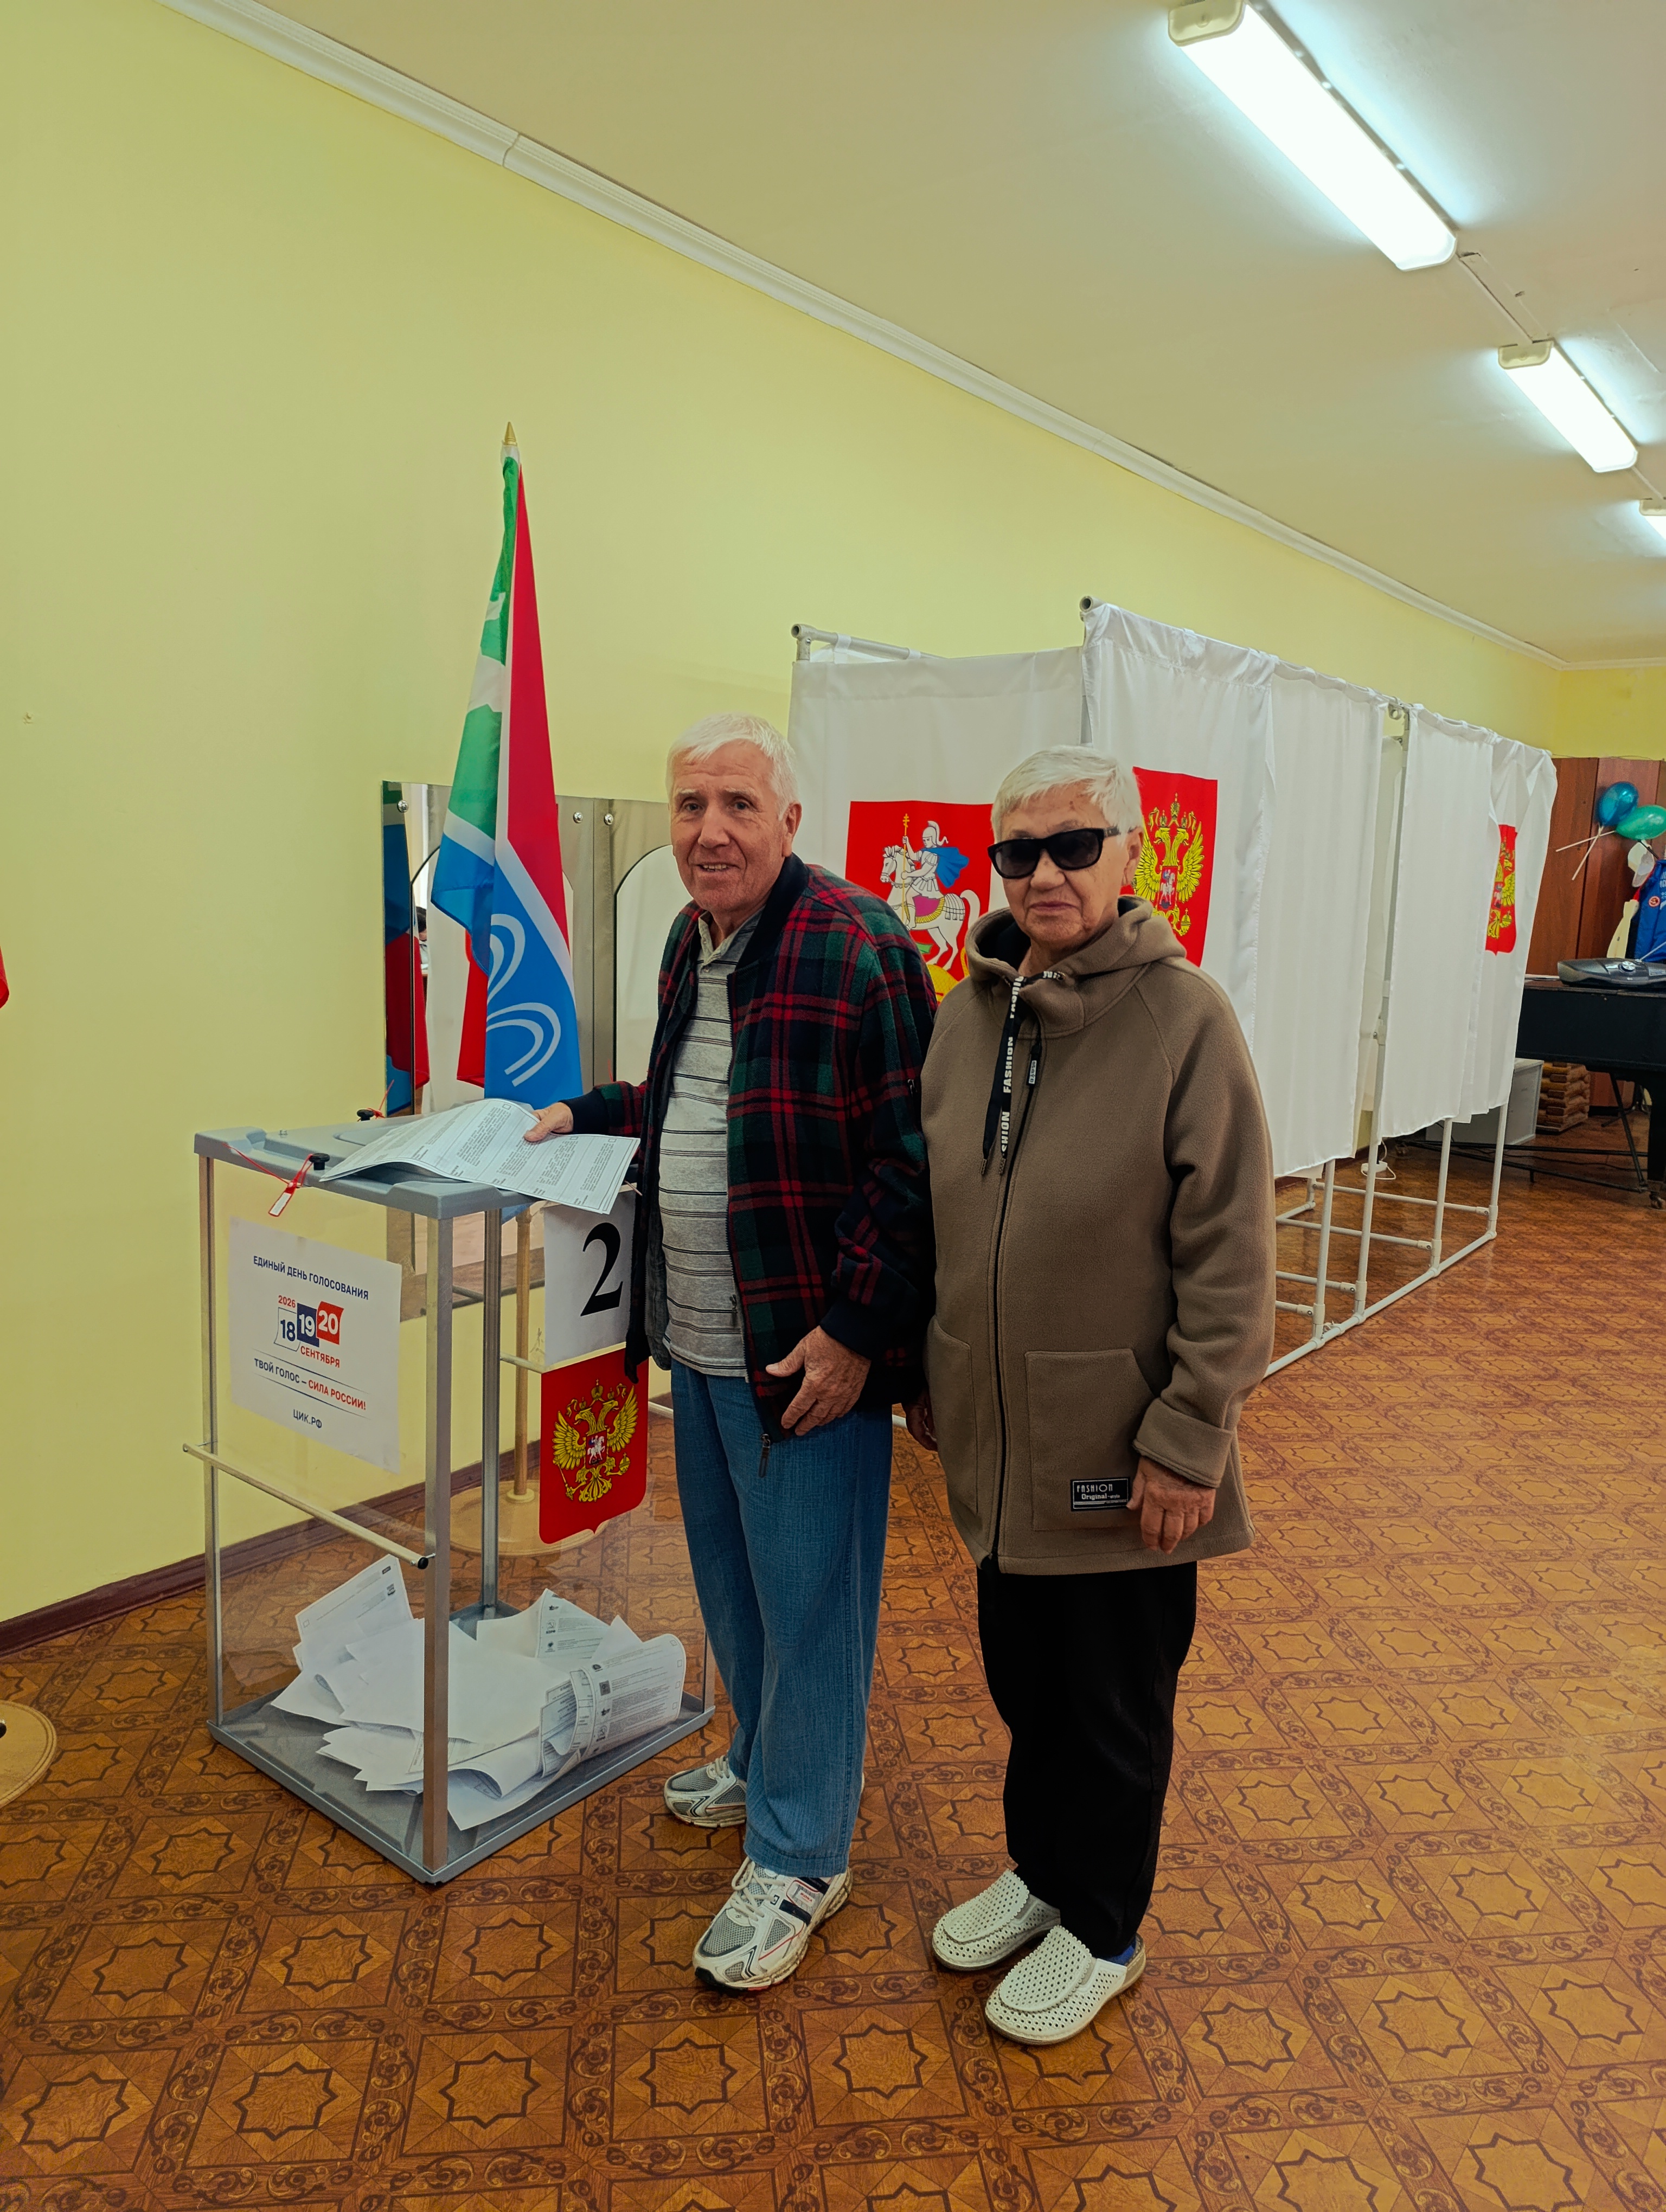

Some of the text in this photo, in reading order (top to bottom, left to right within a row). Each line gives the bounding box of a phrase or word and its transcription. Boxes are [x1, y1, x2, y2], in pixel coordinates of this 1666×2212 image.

[1003, 1037, 1013, 1093] FASHION
[1001, 1111, 1010, 1152] SHION
[254, 1255, 369, 1300] ЕДИНЫЙ ДЕНЬ ГОЛОСОВАНИЯ
[580, 1222, 623, 1317] 2
[278, 1295, 296, 1308] 2026
[280, 1310, 338, 1342] 18 19 20
[300, 1346, 340, 1368] СЕНТЯБРЯ
[254, 1358, 274, 1373] ТВОЙ
[275, 1366, 299, 1384] ГОЛОС
[309, 1379, 329, 1396] СИЛА
[330, 1388, 366, 1410] РОССИИ!
[293, 1409, 323, 1429] ЦИК.РФ
[1077, 1483, 1113, 1493] FASHION
